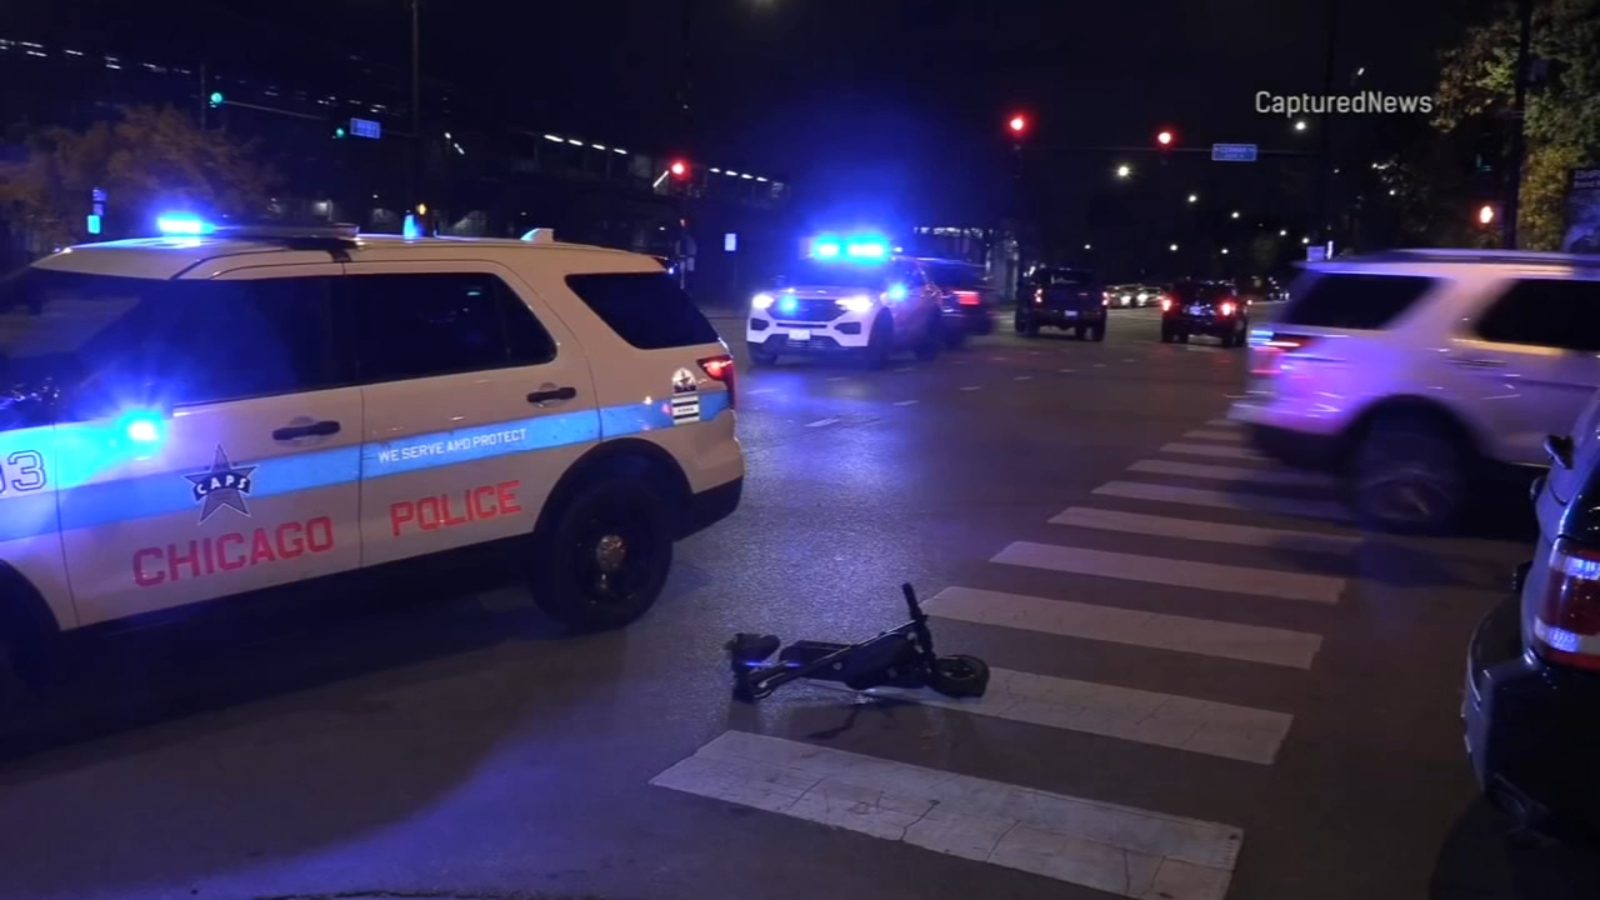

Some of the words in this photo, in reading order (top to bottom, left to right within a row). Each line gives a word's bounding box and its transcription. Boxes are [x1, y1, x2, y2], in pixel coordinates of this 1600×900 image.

[378, 449, 400, 463] WE
[402, 442, 445, 460] SERVE
[446, 437, 471, 451] AND
[473, 428, 527, 447] PROTECT
[0, 450, 47, 493] 3
[196, 474, 247, 495] CAPS
[132, 516, 334, 587] CHICAGO
[390, 480, 522, 537] POLICE
